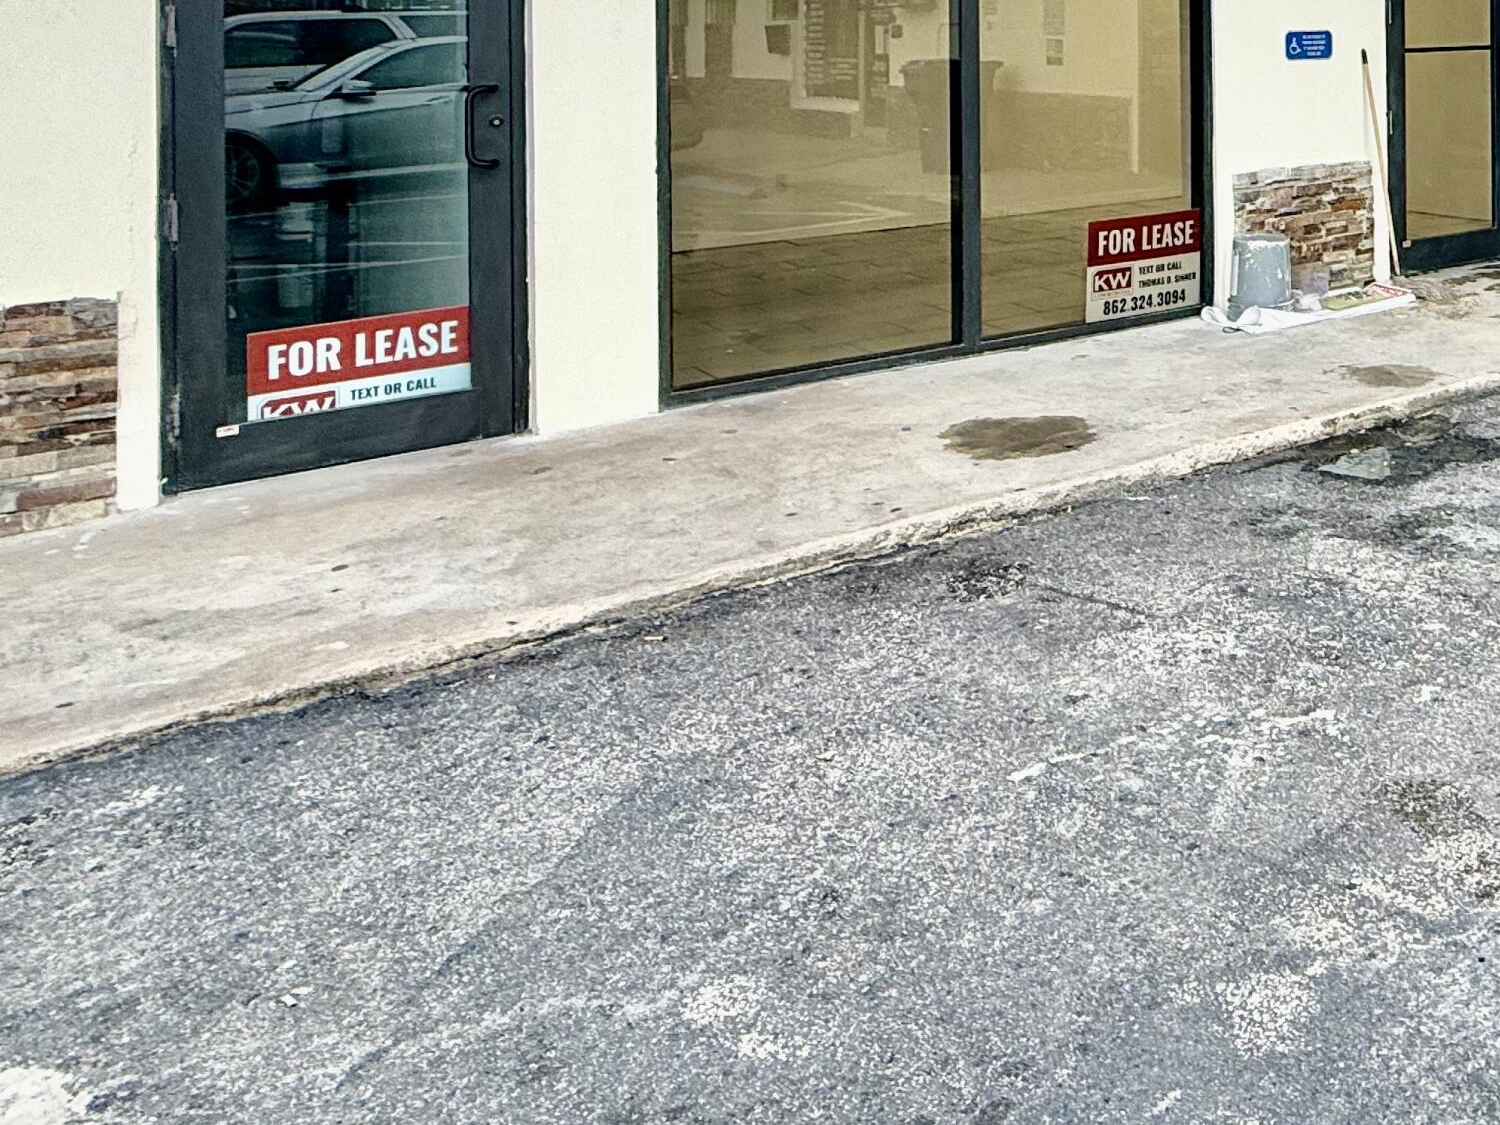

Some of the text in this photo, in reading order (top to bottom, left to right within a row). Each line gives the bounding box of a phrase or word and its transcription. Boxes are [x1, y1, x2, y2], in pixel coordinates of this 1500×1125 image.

[1098, 220, 1195, 257] FOR LEASE
[1094, 270, 1131, 292] KW
[1138, 265, 1154, 276] TEXT
[1166, 261, 1182, 271] CALL
[1103, 288, 1186, 316] 862.324.3094
[267, 320, 459, 380] FOR LEASE
[349, 376, 437, 401] TEXT OR CALL
